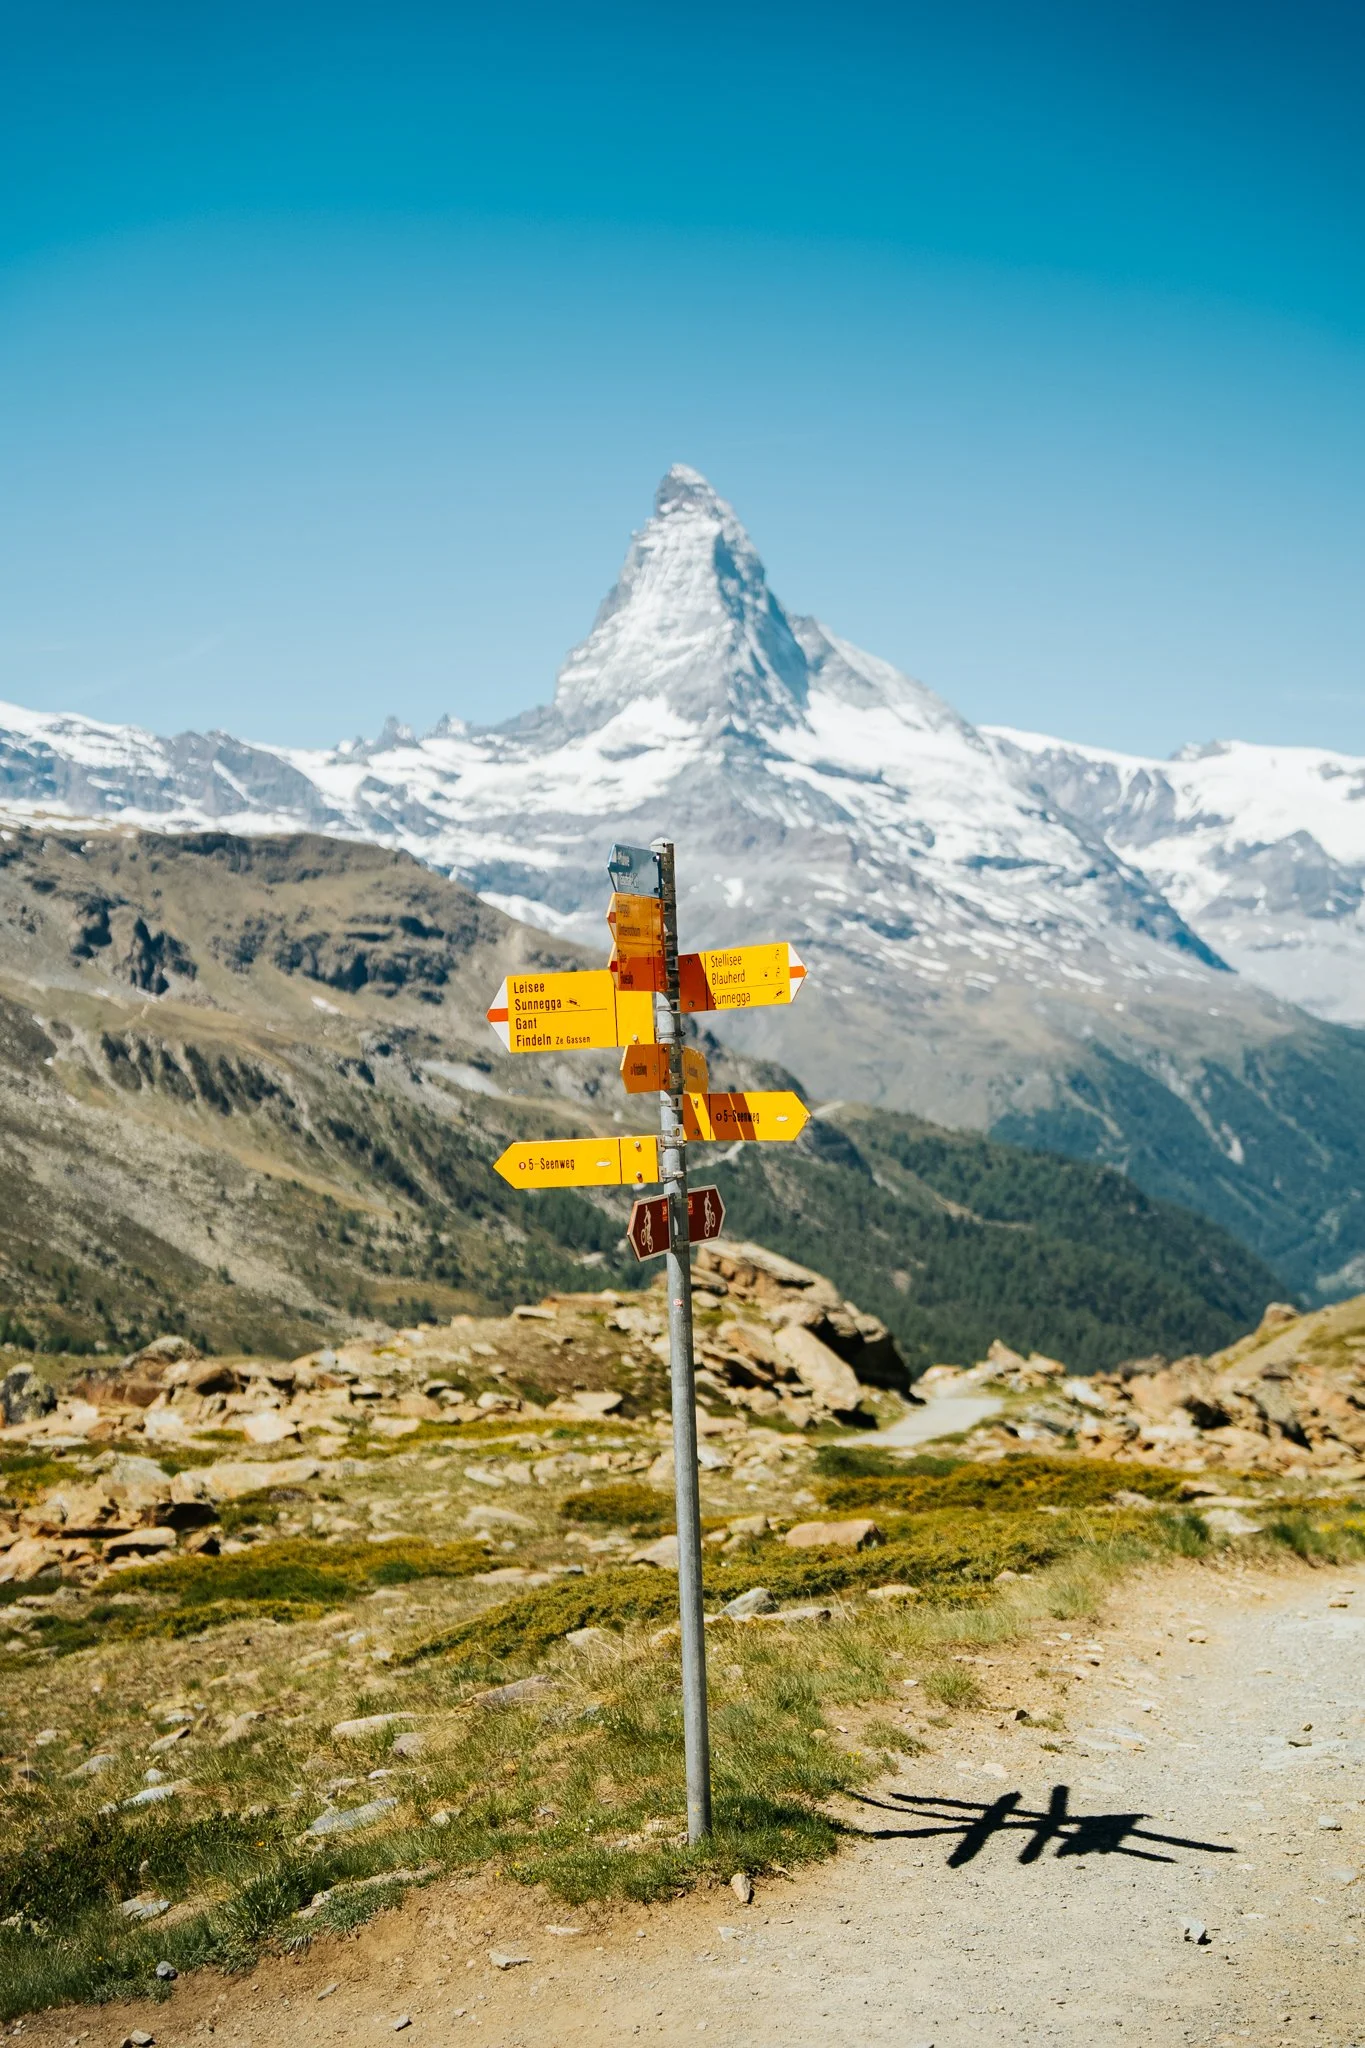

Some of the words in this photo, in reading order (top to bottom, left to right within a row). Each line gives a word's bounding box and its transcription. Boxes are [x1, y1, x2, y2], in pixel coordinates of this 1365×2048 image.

[710, 954, 742, 968] Stellisee
[711, 969, 746, 985] Blauherd
[513, 981, 545, 994] Leisee
[514, 998, 562, 1011] Sunnegga
[712, 992, 751, 1006] Sunnegga
[515, 1017, 537, 1030] Gant
[516, 1034, 552, 1047] Findeln
[555, 1036, 564, 1045] Ze
[566, 1035, 591, 1044] Gassen
[723, 1109, 760, 1124] 5-Seenweg
[528, 1157, 575, 1171] 5-Seenweg
